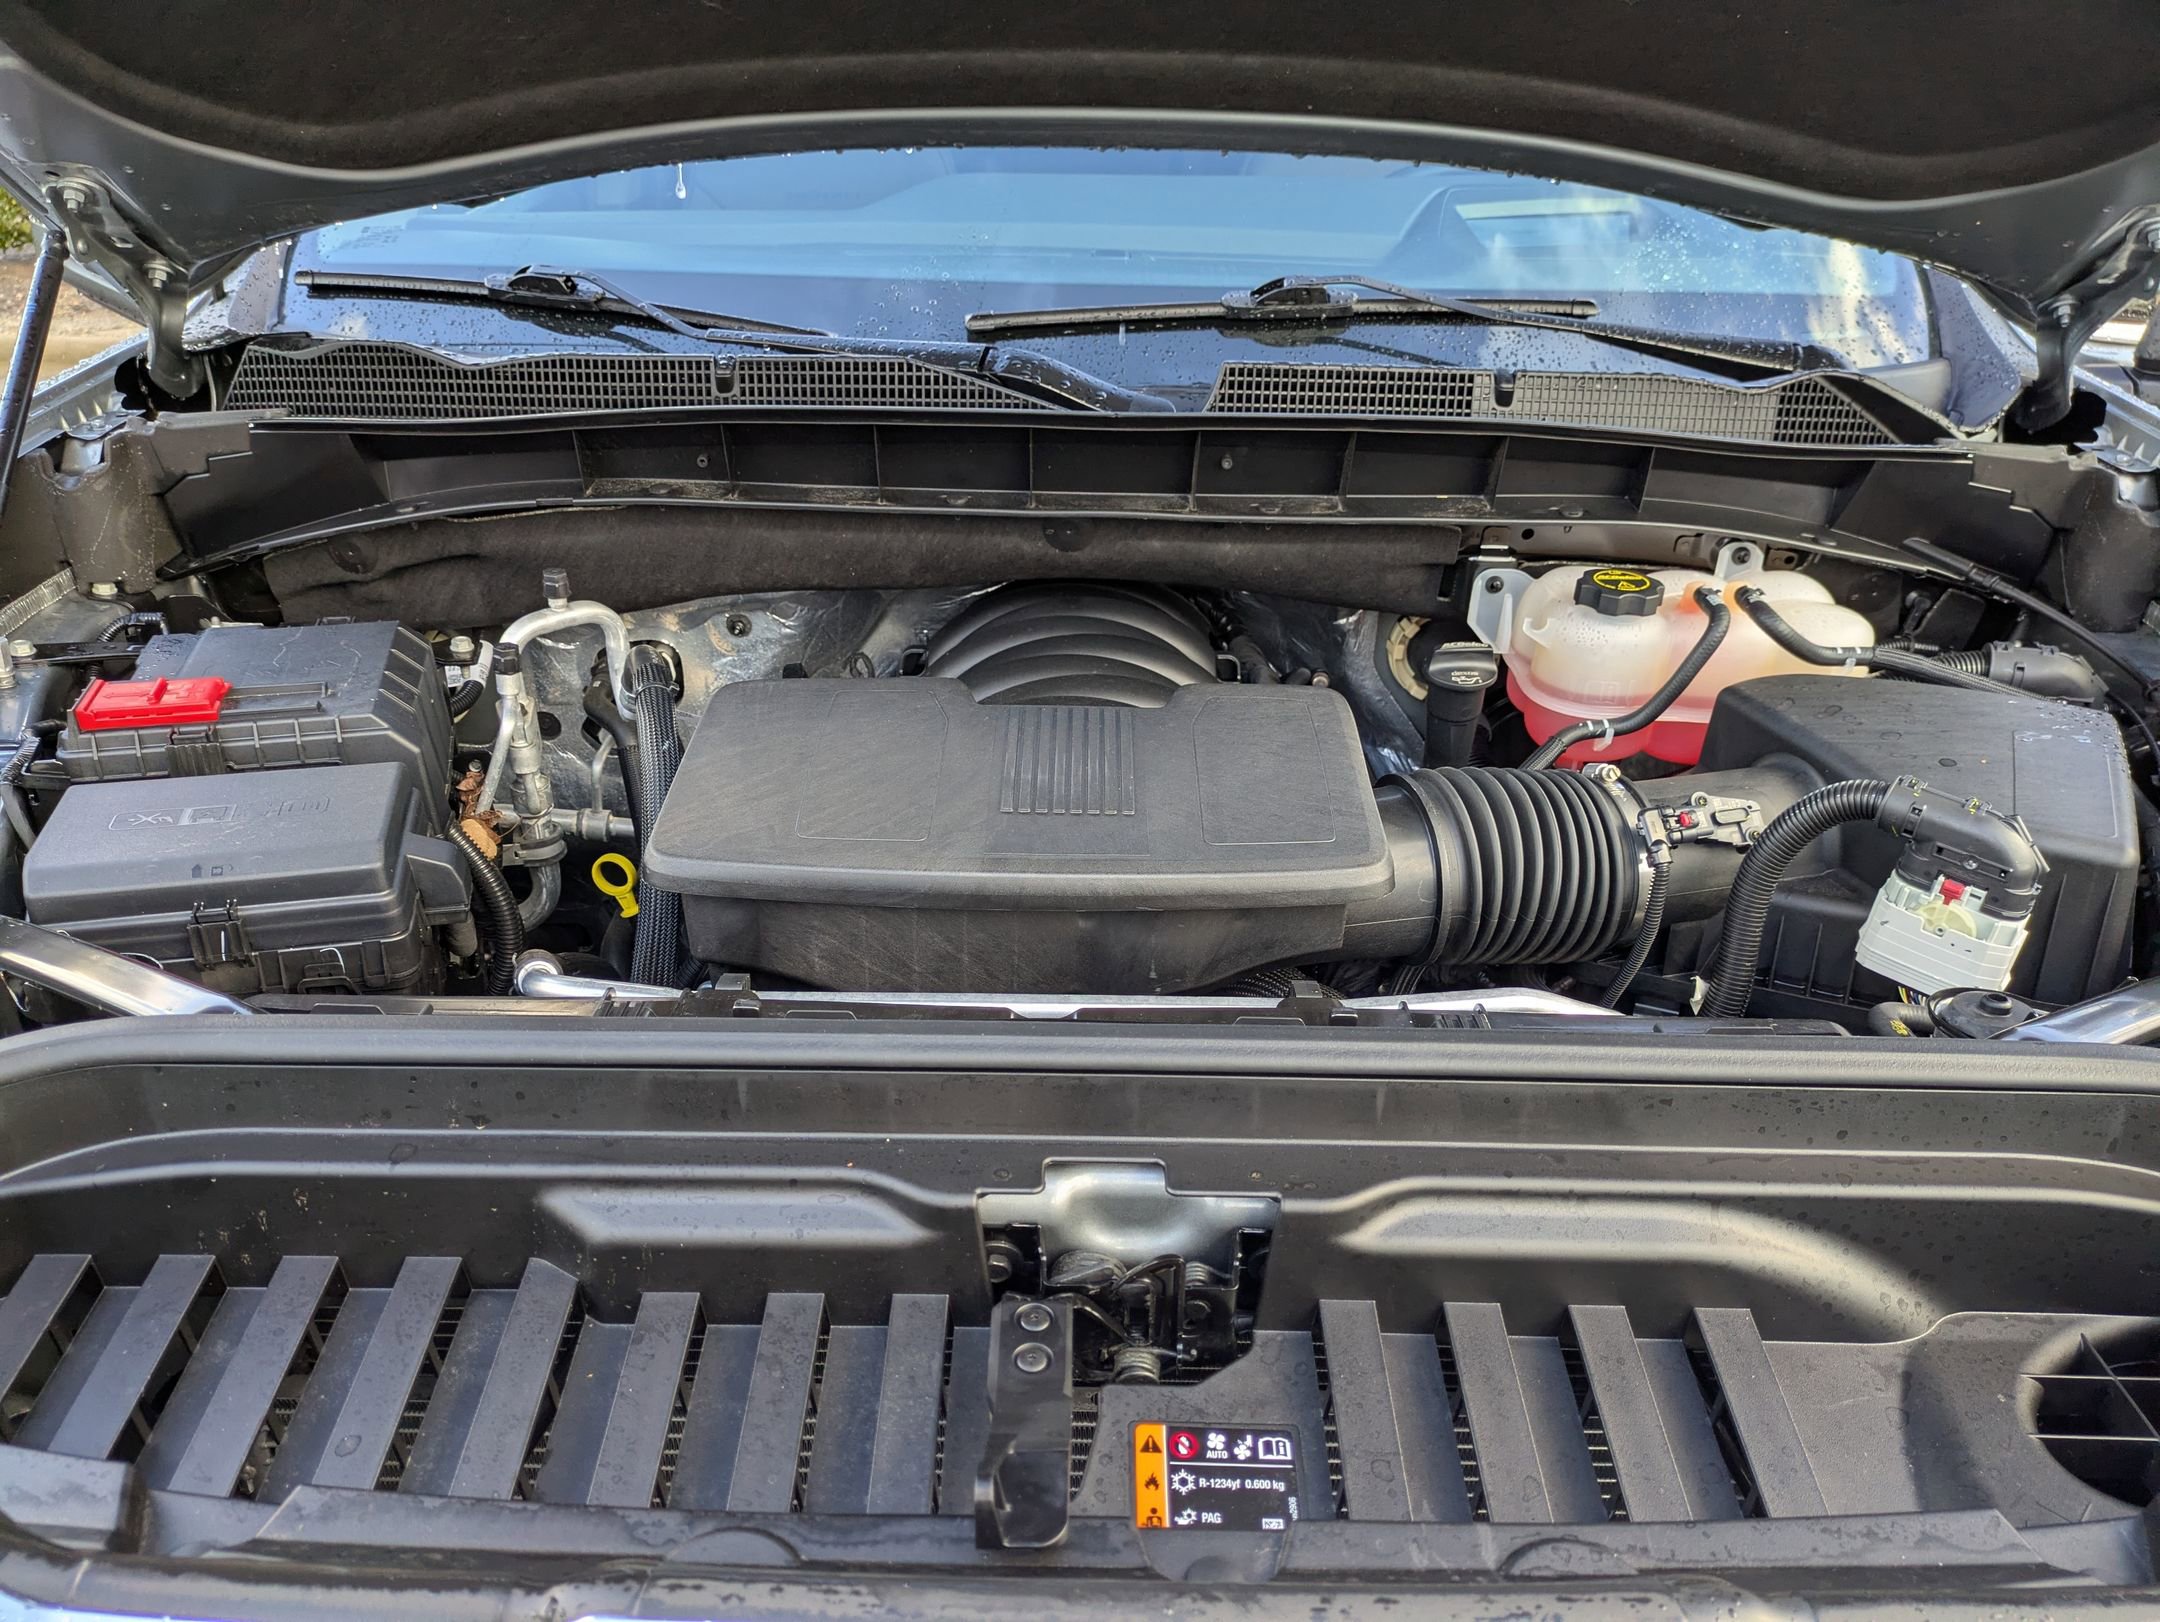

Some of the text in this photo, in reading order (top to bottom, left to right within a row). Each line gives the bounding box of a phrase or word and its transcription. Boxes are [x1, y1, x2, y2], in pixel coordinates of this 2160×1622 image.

[1206, 1450, 1228, 1459] AUTO
[1199, 1478, 1285, 1492] R-1234yf 0.600 kg
[1201, 1512, 1222, 1524] PAG
